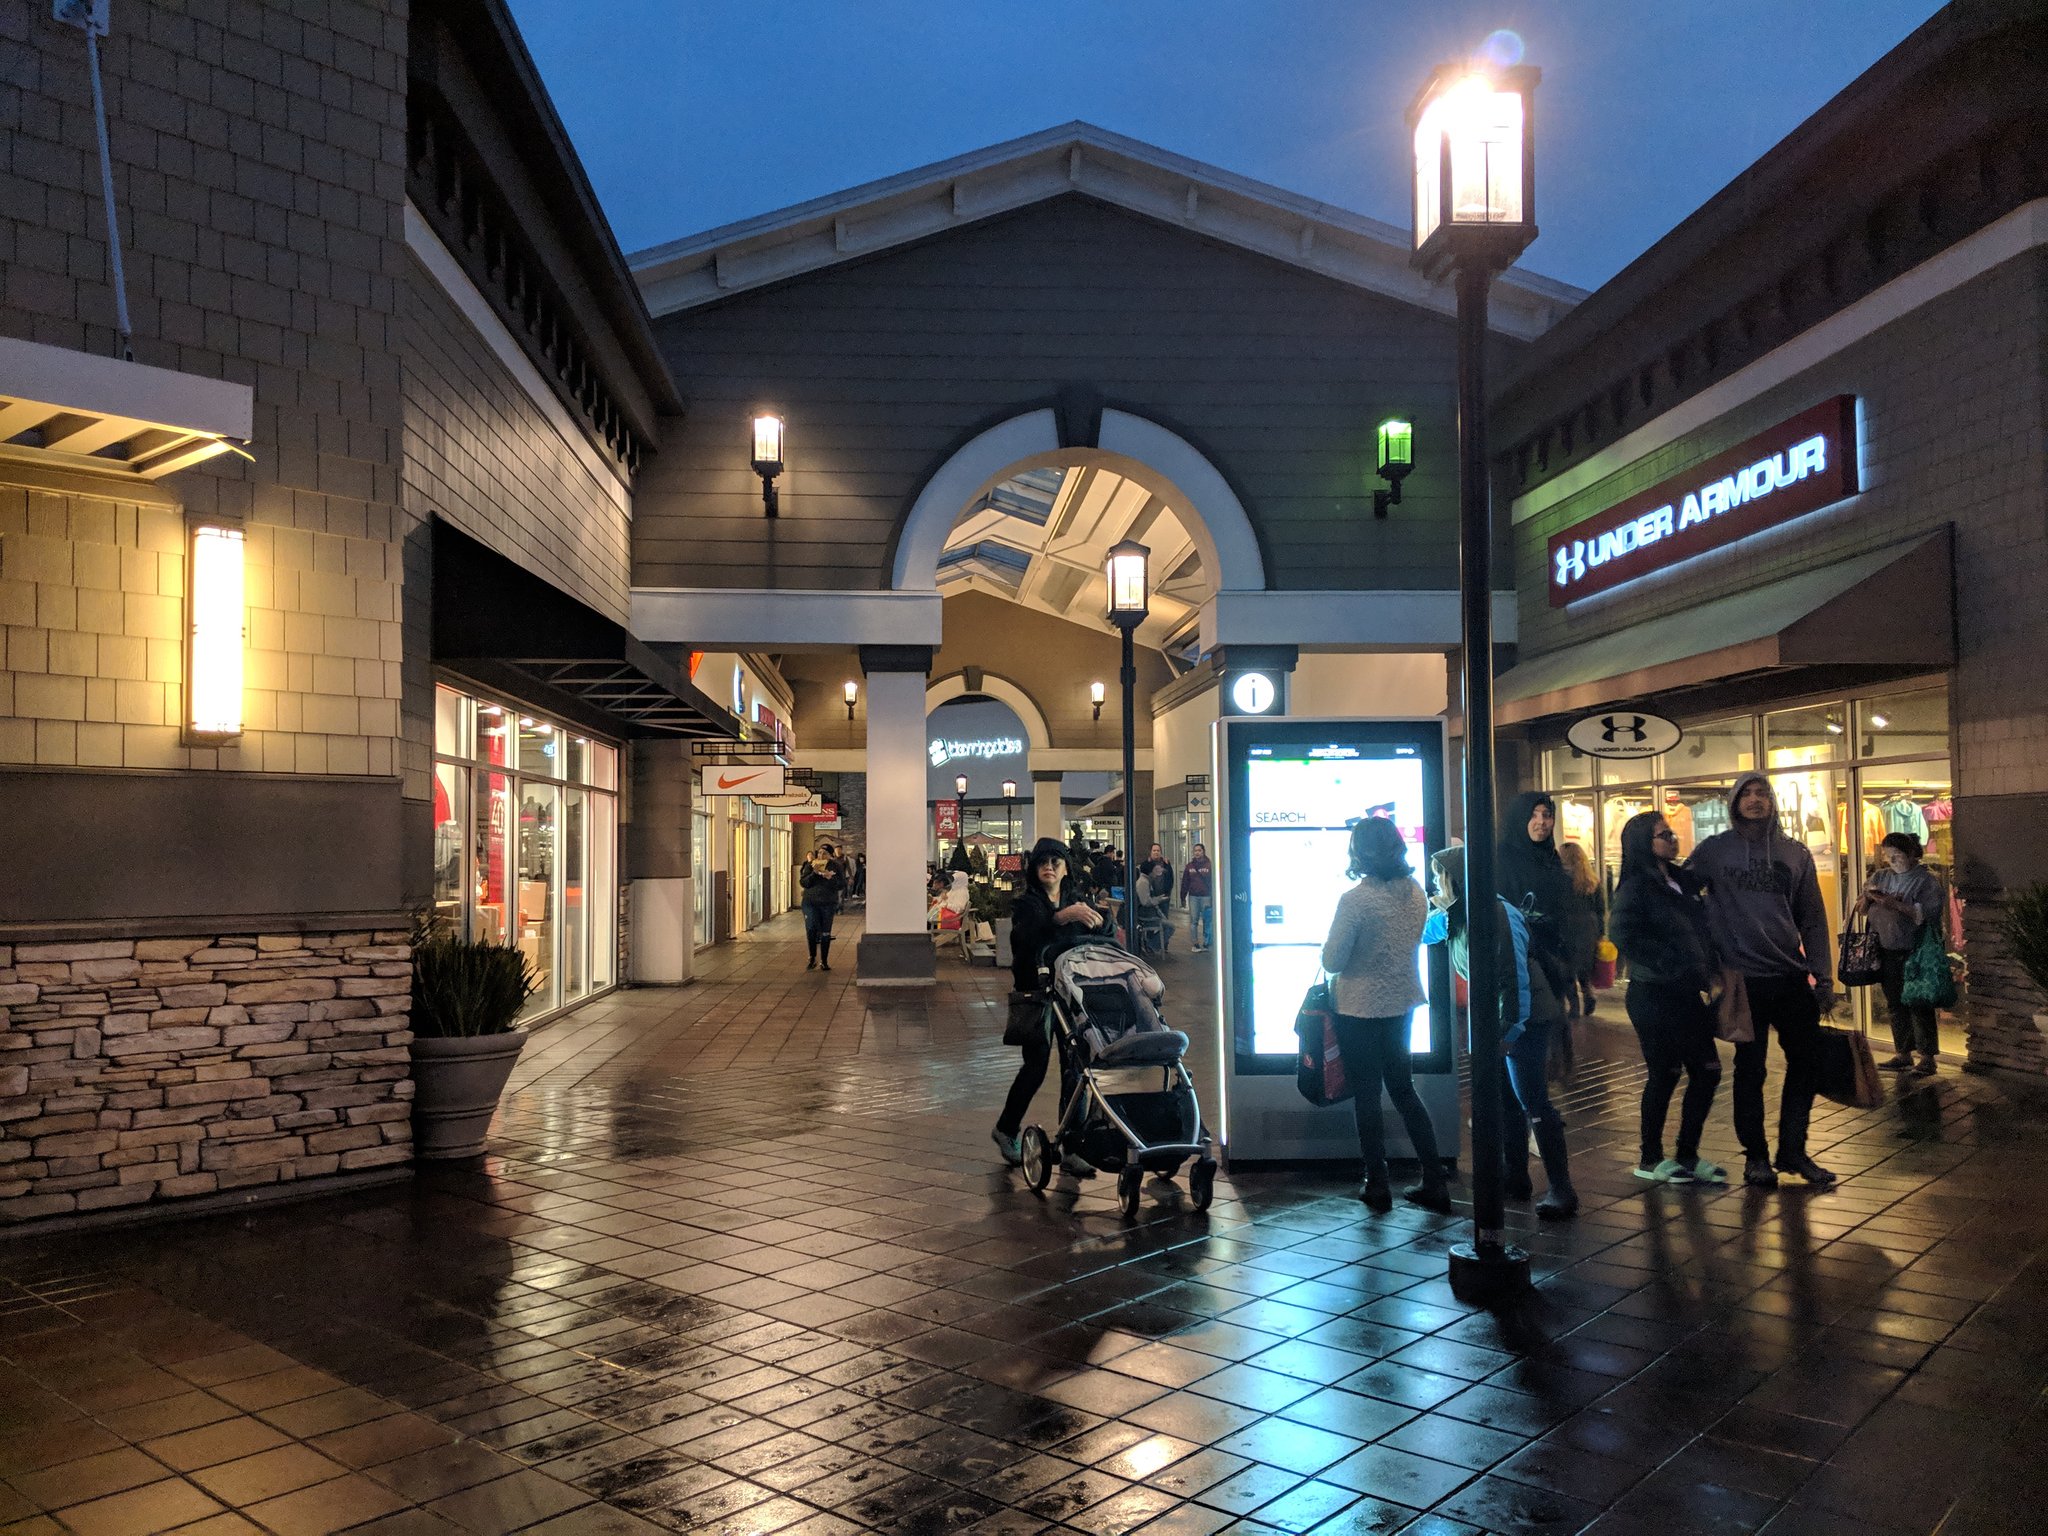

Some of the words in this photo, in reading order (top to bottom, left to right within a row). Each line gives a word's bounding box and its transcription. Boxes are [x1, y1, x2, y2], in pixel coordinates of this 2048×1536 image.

[1587, 503, 1675, 567] UNDER
[1678, 434, 1826, 530] ARMOUR
[1255, 812, 1307, 823] SEARCH
